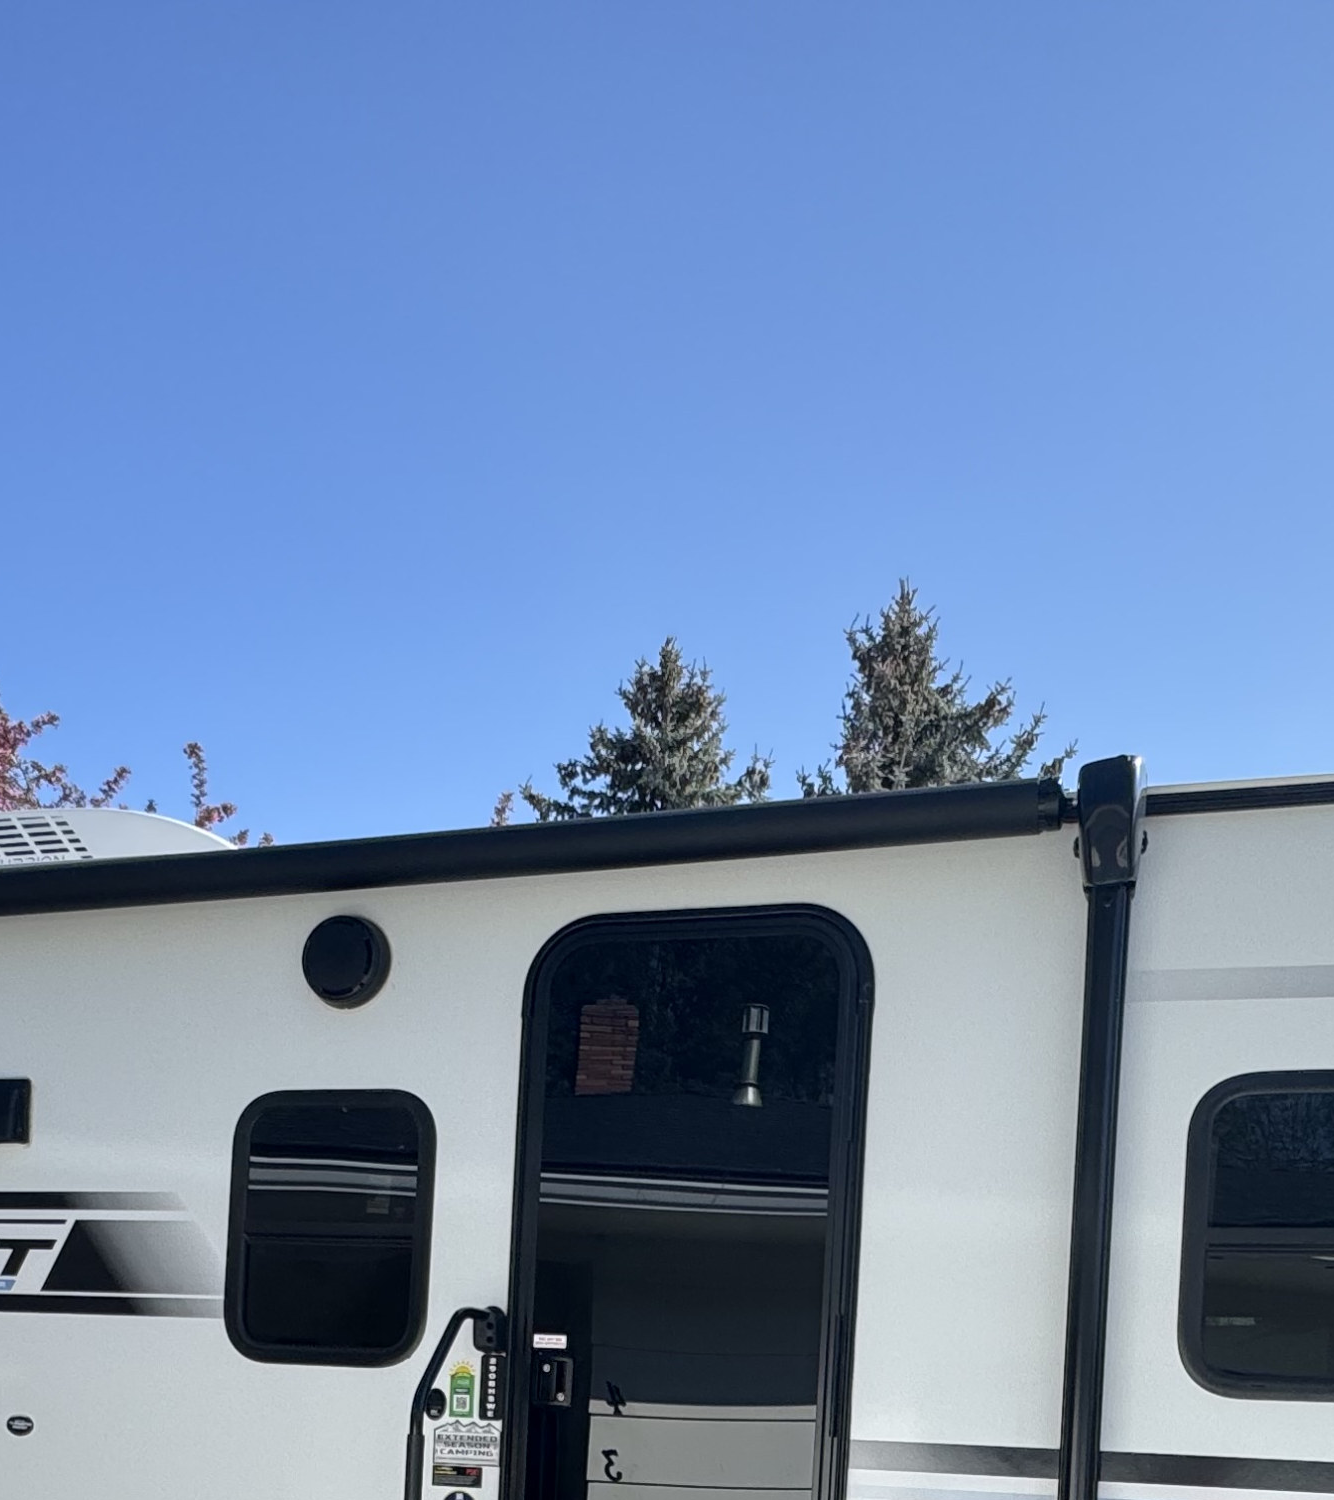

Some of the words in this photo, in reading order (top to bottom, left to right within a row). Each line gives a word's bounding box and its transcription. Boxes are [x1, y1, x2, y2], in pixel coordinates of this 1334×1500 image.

[436, 1433, 498, 1443] EXTENDED
[443, 1441, 491, 1449] SEASON
[439, 1448, 494, 1457] CAMPING
